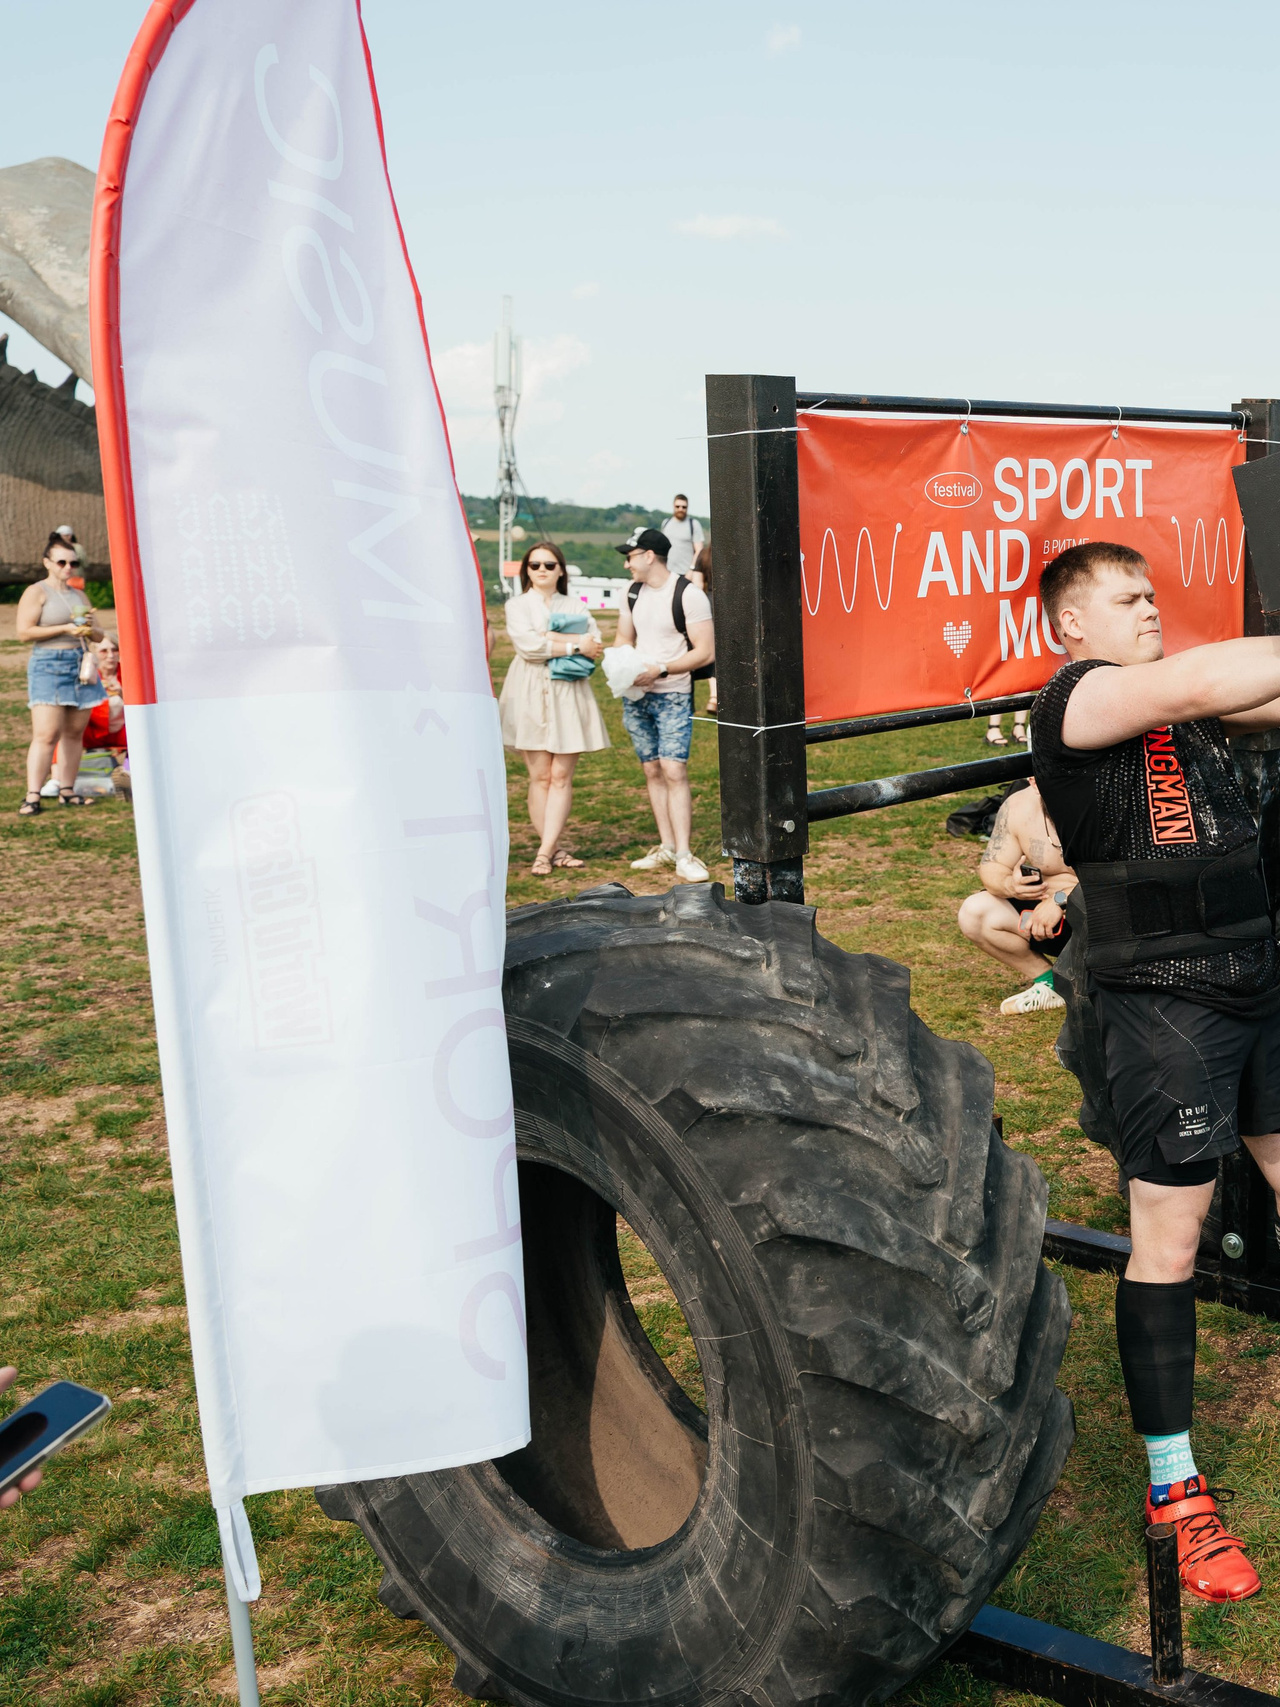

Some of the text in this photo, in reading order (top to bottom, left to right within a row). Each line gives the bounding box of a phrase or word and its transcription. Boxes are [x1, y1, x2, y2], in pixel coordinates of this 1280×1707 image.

[933, 457, 1153, 522] festival SPORT
[917, 529, 1030, 598] AND
[1147, 725, 1192, 840] NGMAN
[1150, 1450, 1192, 1467] ОЛО
